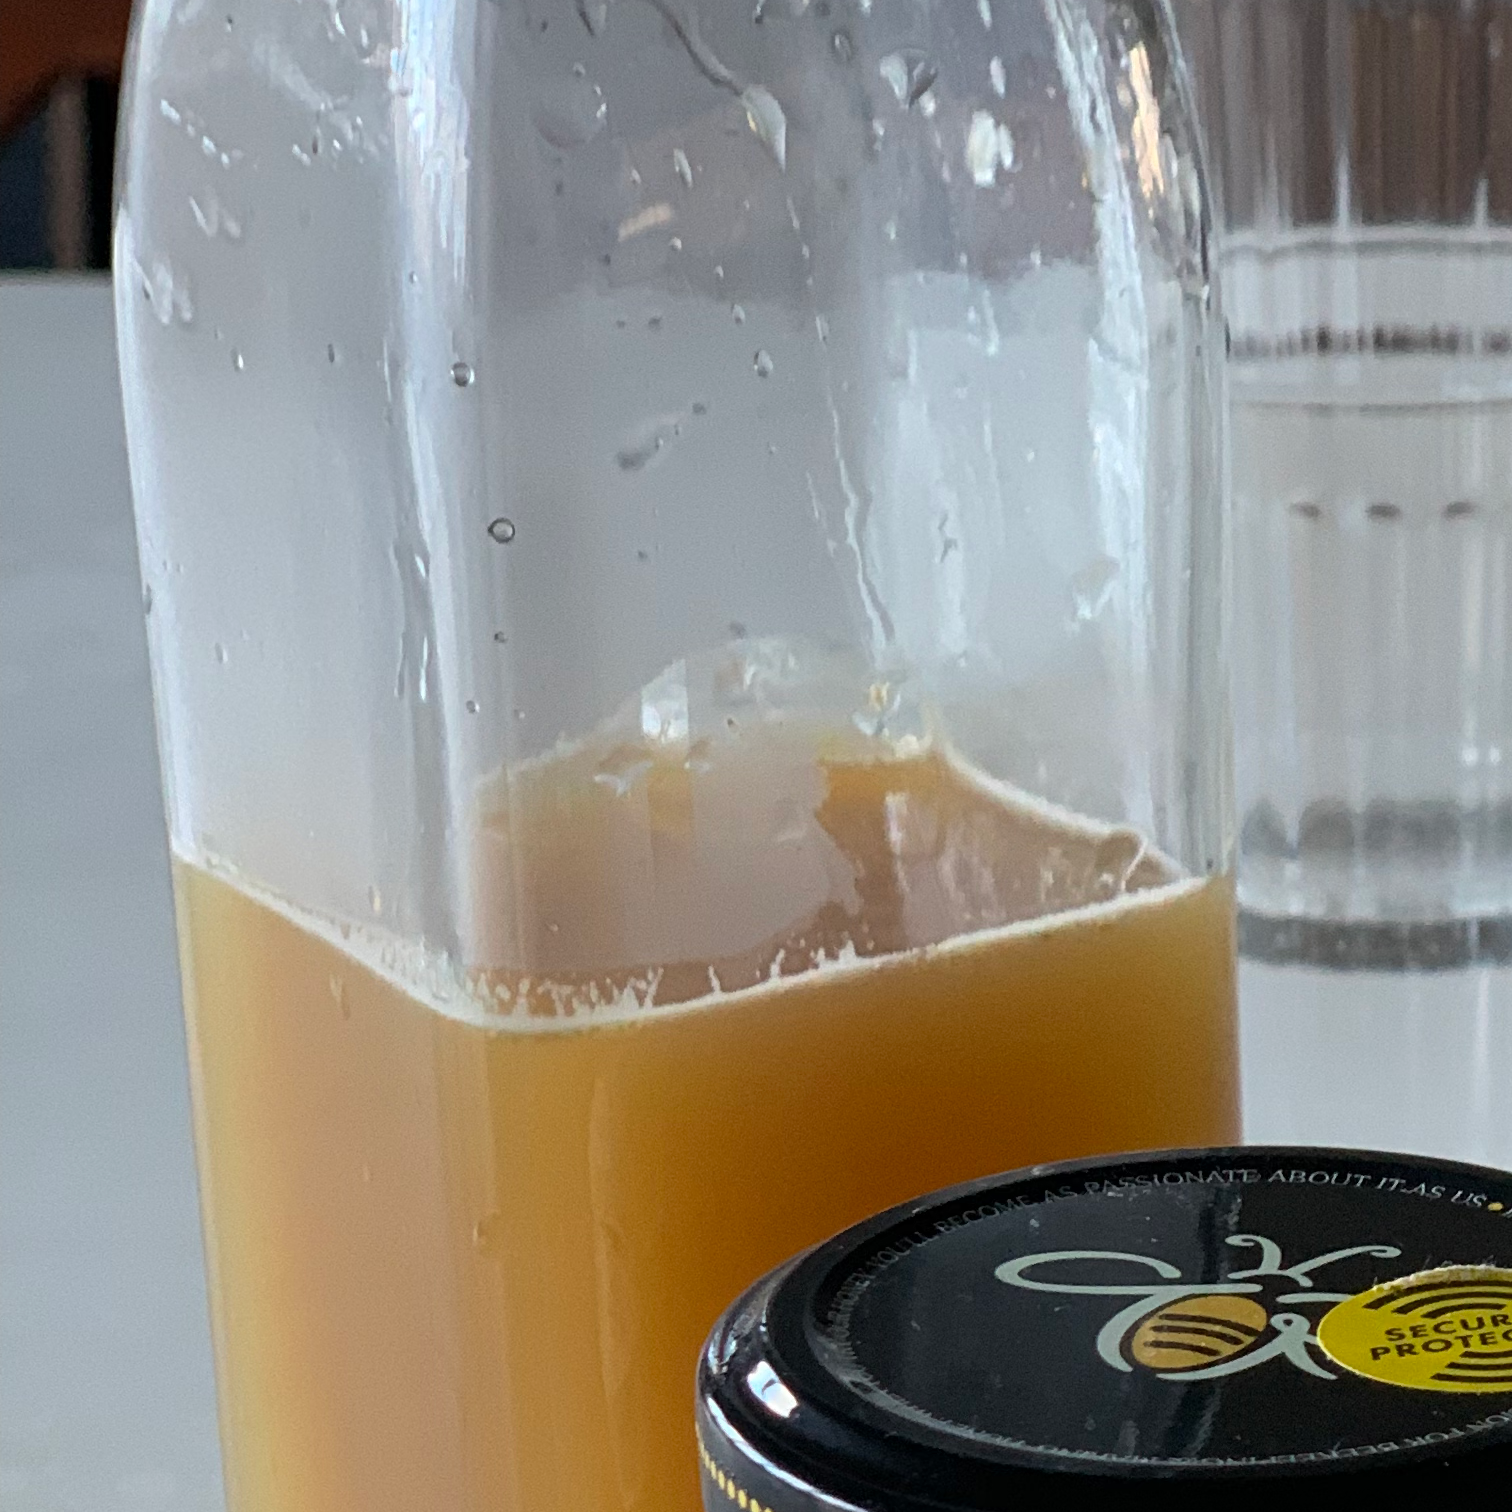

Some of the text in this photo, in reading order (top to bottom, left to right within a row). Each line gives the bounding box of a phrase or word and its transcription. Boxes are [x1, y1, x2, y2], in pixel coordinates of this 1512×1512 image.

[934, 1194, 1033, 1234] BECOME
[1044, 1184, 1078, 1204] AS
[1084, 1168, 1261, 1196] PASSIONATE
[1268, 1169, 1373, 1188] ABOUT
[1450, 1189, 1488, 1209] US
